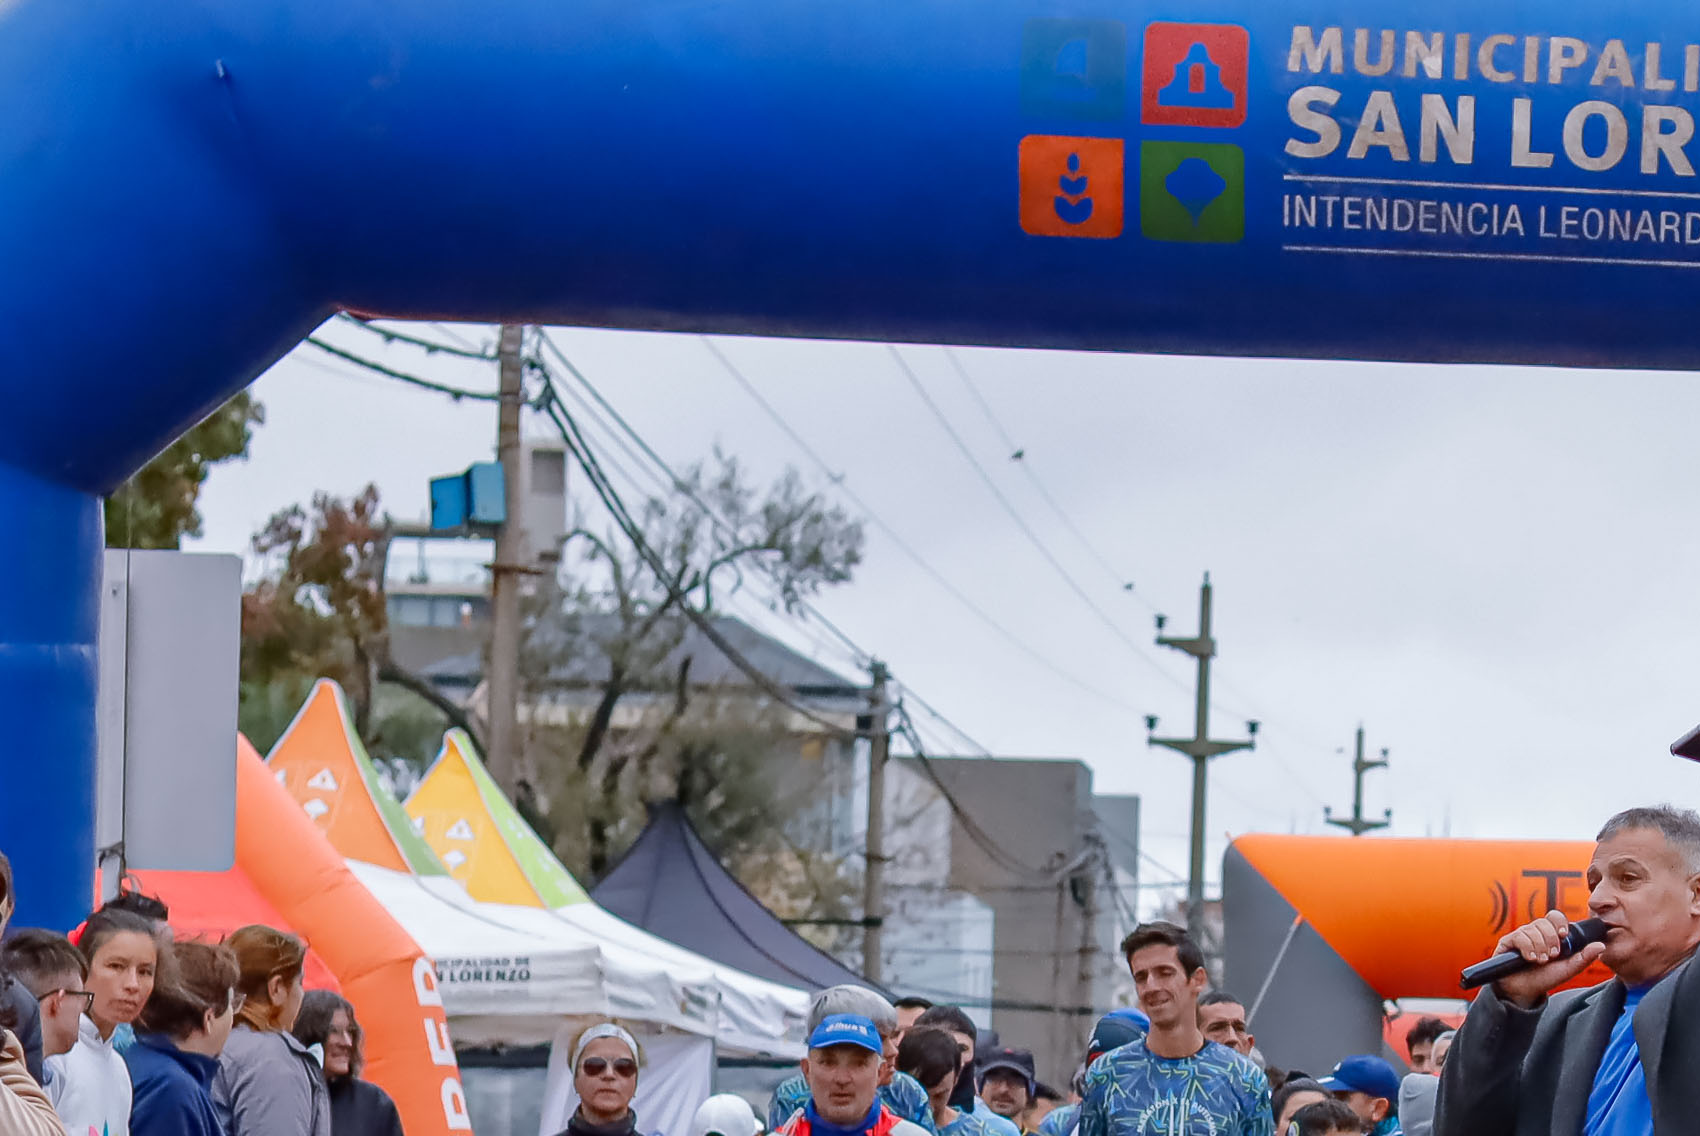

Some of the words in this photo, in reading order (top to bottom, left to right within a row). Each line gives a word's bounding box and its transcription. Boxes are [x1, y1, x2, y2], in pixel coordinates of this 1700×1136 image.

[1284, 85, 1476, 165] SAN
[1283, 194, 1525, 237] INTENDENCIA
[449, 968, 531, 983] LORENZO
